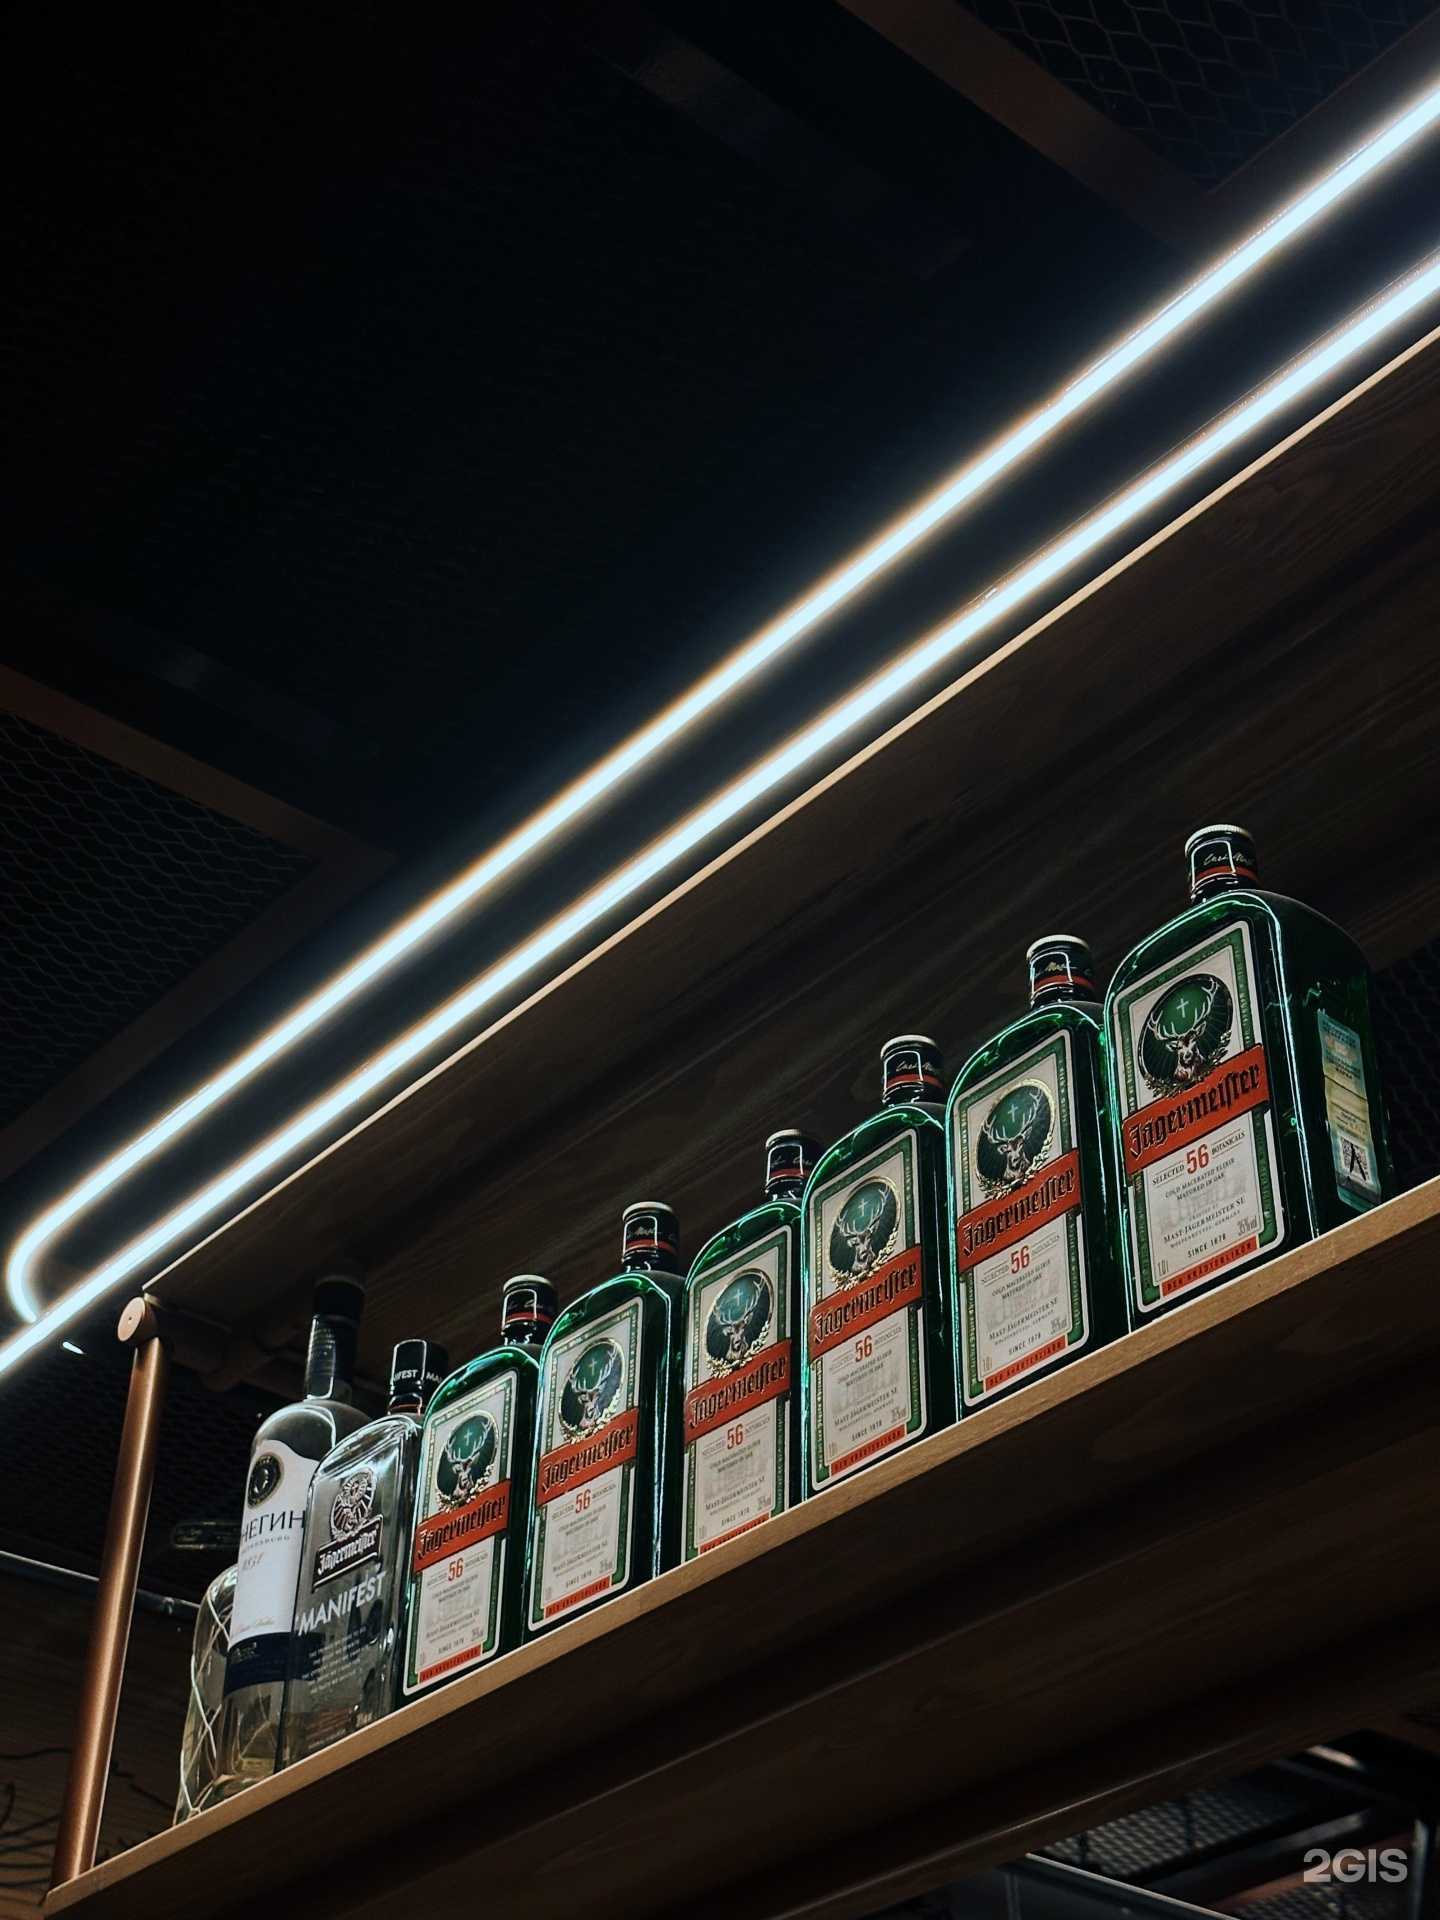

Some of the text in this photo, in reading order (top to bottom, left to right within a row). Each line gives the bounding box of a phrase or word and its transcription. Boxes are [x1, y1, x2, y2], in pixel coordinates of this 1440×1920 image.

[1130, 1064, 1260, 1160] Jägermeister
[1152, 1130, 1245, 1186] SELECTED 56 BOTANICALS
[963, 1167, 1075, 1257] Jägermeister
[1010, 1243, 1029, 1275] 56
[1187, 1240, 1207, 1259] SINCE
[814, 1262, 918, 1344] Jägermeister
[855, 1333, 872, 1363] 56
[689, 1358, 786, 1428] Jägermeister
[542, 1424, 633, 1494] Jägermeister
[726, 1422, 743, 1451] 56
[241, 1510, 305, 1542] НЕГИН
[418, 1496, 505, 1560] Jägermeister
[575, 1486, 591, 1514] 56
[447, 1555, 464, 1582] 56
[298, 1571, 386, 1636] MANIFEST
